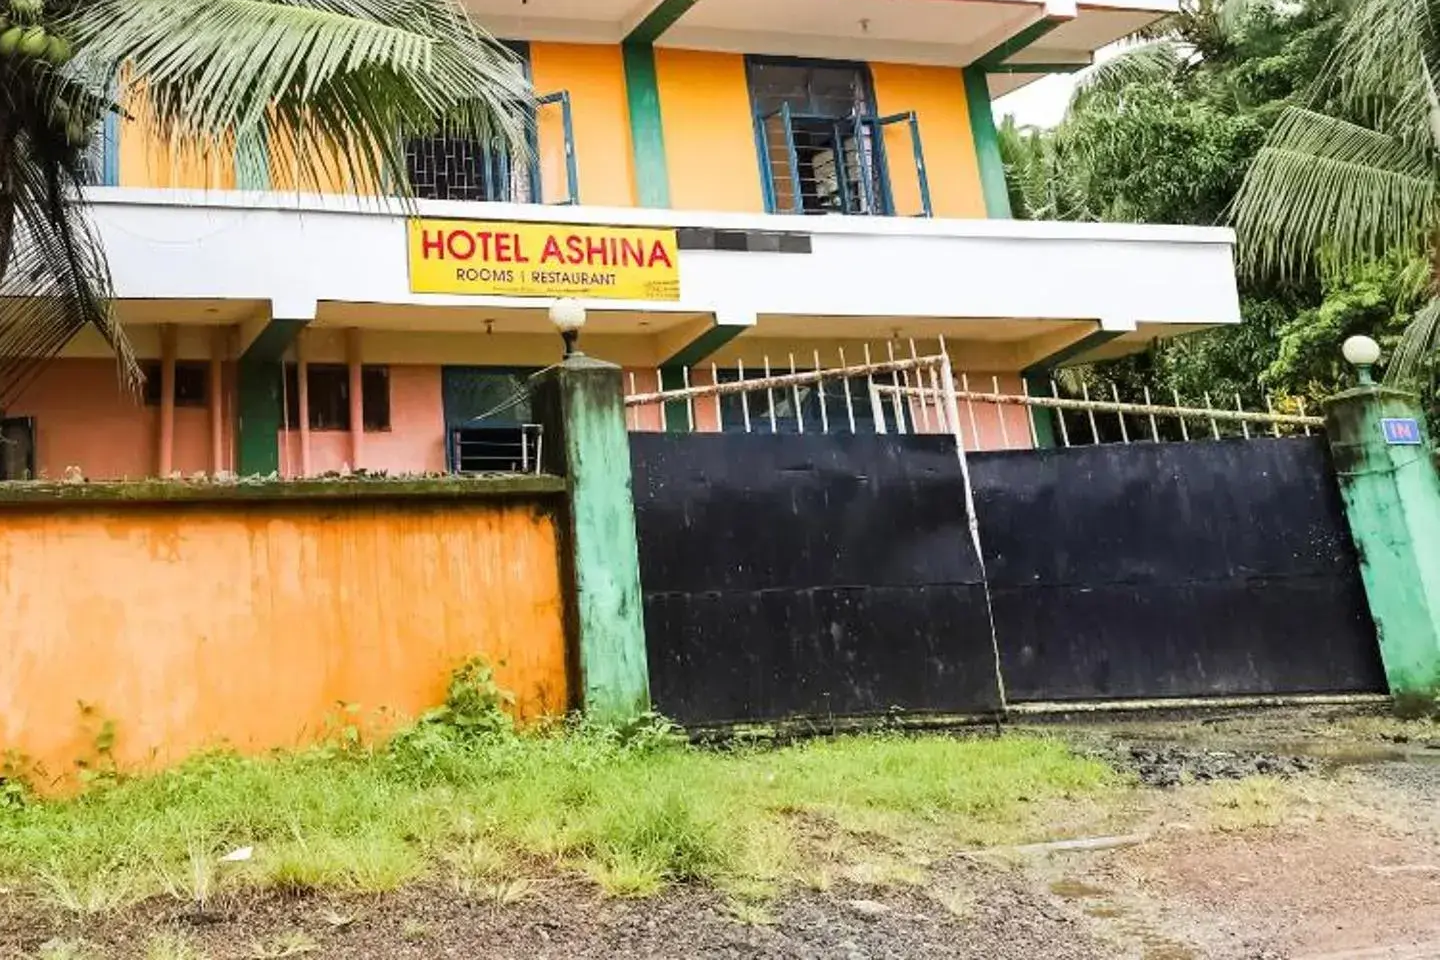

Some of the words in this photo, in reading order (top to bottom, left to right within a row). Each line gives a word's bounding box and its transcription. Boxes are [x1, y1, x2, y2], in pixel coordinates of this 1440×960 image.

[422, 230, 529, 264] HOTEL
[540, 235, 672, 268] ASHINA
[456, 268, 514, 283] ROOMS
[531, 271, 616, 286] RESTAURANT
